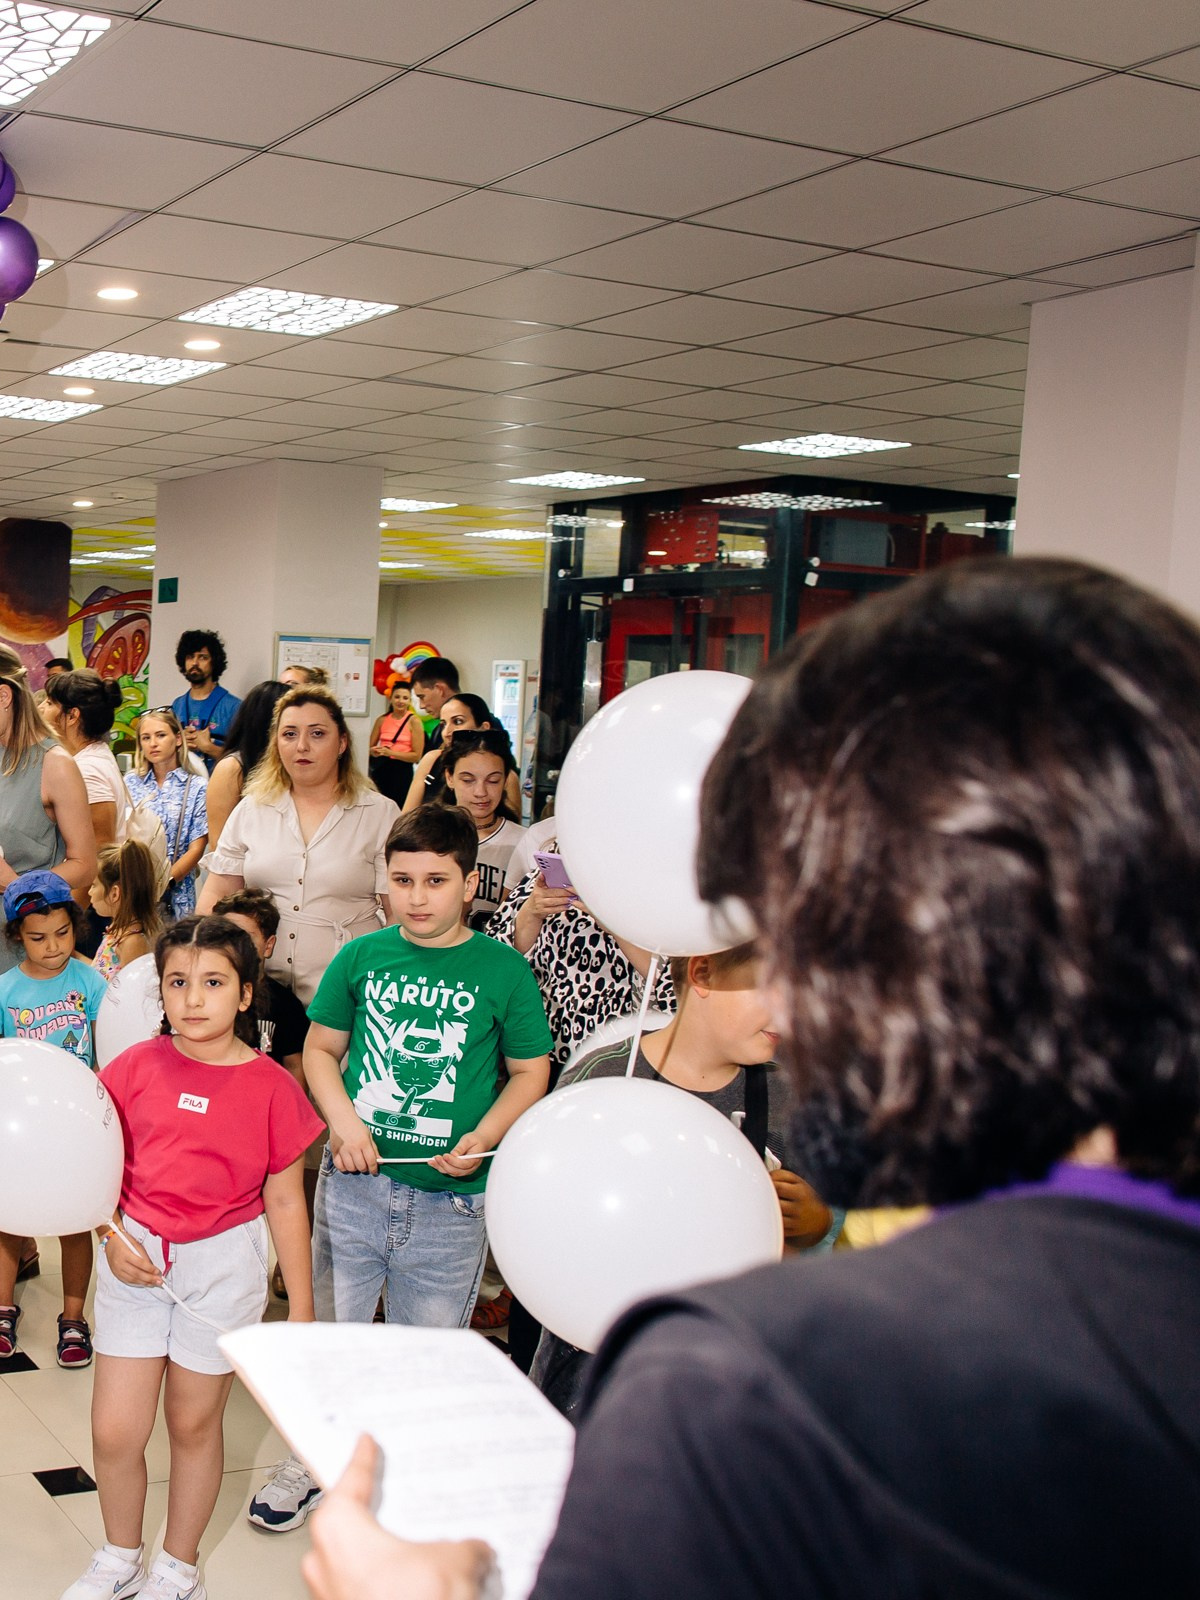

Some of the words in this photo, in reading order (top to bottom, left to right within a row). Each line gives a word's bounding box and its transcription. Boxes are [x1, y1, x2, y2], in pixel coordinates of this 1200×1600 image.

[367, 970, 480, 994] UZUMAKI
[364, 979, 476, 1014] NARUTO
[45, 999, 76, 1017] CAN
[182, 1097, 203, 1109] FILA
[386, 1129, 449, 1148] SHIPPÜDEN
